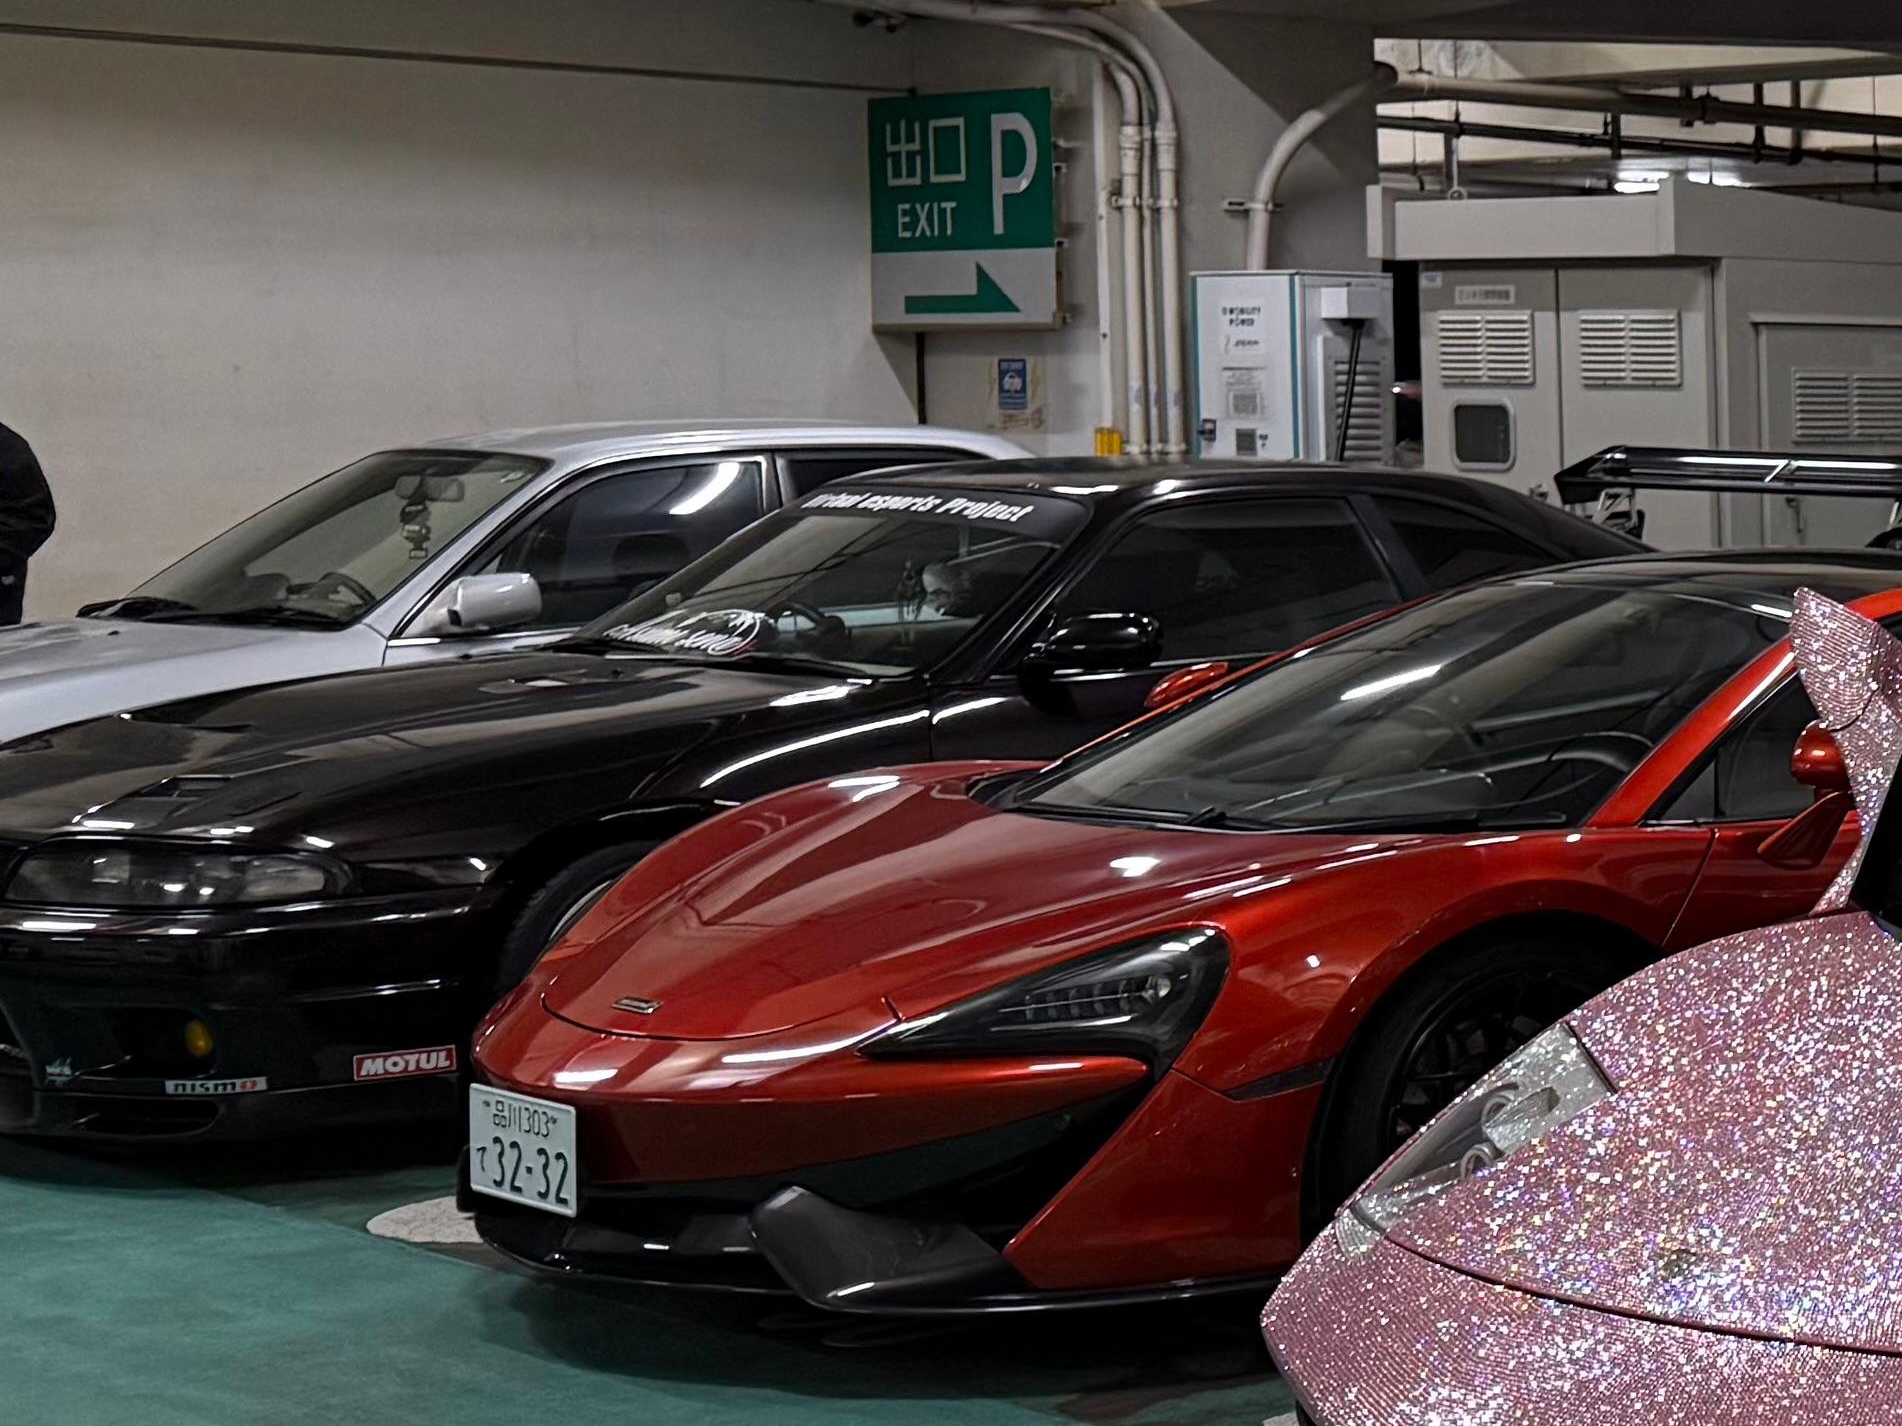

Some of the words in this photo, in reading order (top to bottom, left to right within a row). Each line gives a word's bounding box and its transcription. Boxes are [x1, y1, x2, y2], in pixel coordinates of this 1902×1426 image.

[885, 117, 967, 188] 出口
[991, 112, 1038, 235] P
[898, 200, 957, 238] EXIT
[360, 1048, 451, 1076] MOTUL
[492, 1136, 569, 1205] 32-32
